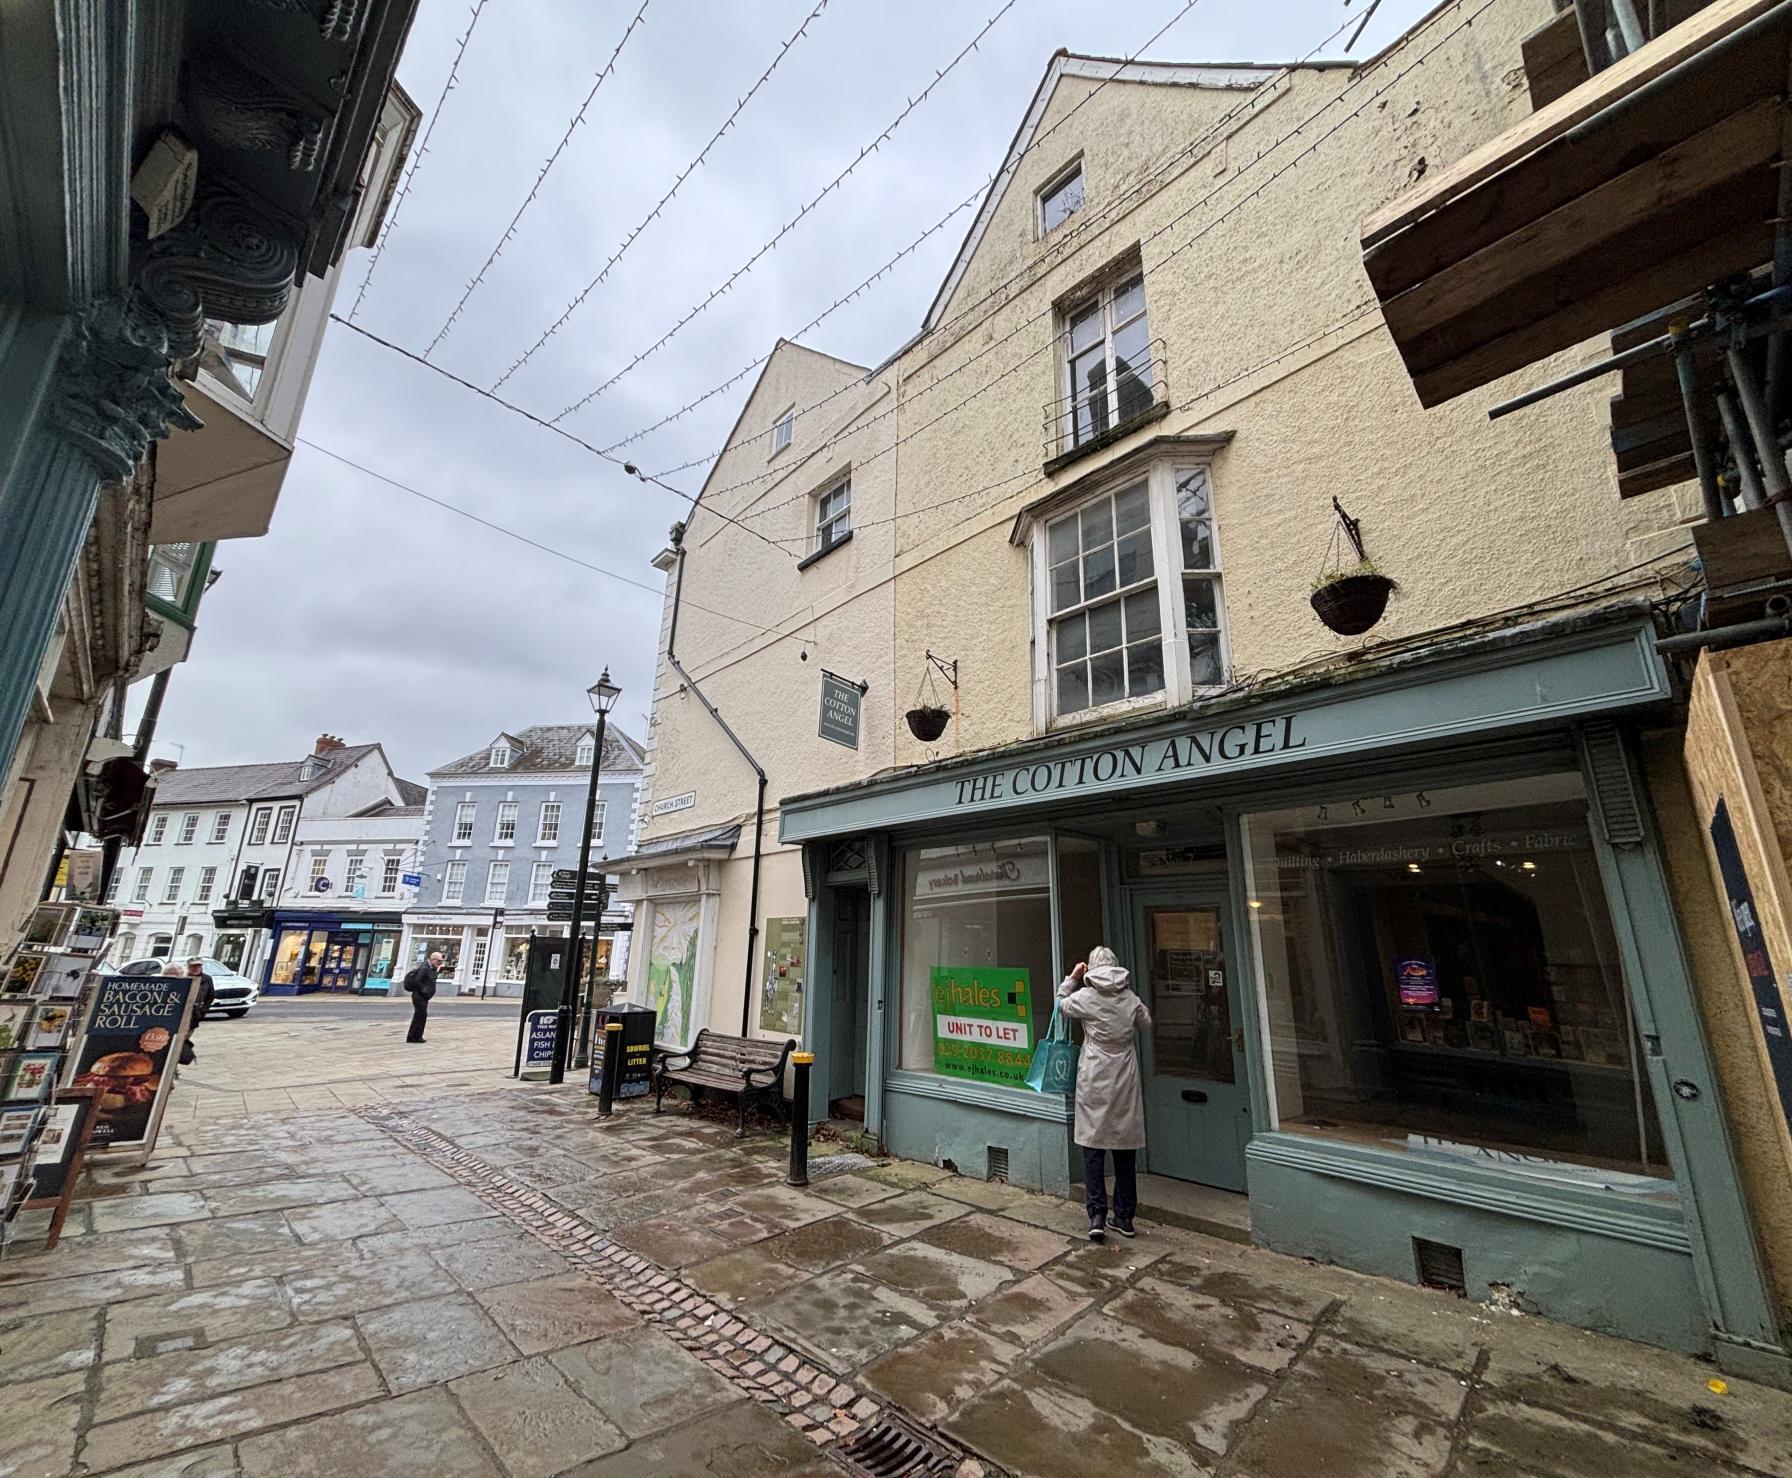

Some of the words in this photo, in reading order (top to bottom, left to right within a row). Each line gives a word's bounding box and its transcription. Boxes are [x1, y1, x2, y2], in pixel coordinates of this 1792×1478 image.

[834, 689, 849, 702] THE
[824, 697, 856, 716] COTTON
[827, 710, 853, 726] ANGEL
[955, 772, 1005, 805] THE
[1011, 745, 1148, 796] COTTON
[1154, 714, 1307, 772] ANGEL
[654, 800, 674, 812] CHURCH
[674, 795, 693, 808] STREET
[1338, 846, 1431, 865] Haberdashery
[1451, 837, 1502, 856] Crafts
[1525, 832, 1578, 849] Fabric
[107, 982, 170, 991] HOMEMADE
[935, 977, 1001, 1010] ejhales
[103, 991, 163, 1004] BACON
[166, 991, 181, 1004] &
[99, 1003, 175, 1016] SAUSAGE
[94, 1016, 140, 1029] ROLL
[947, 1021, 974, 1036] UNIT
[977, 1024, 993, 1038] TO
[996, 1026, 1019, 1041] LET
[533, 1041, 551, 1049] FISH
[627, 1057, 647, 1066] LITTER
[945, 1063, 1024, 1081] www.ejhales.co.uk
